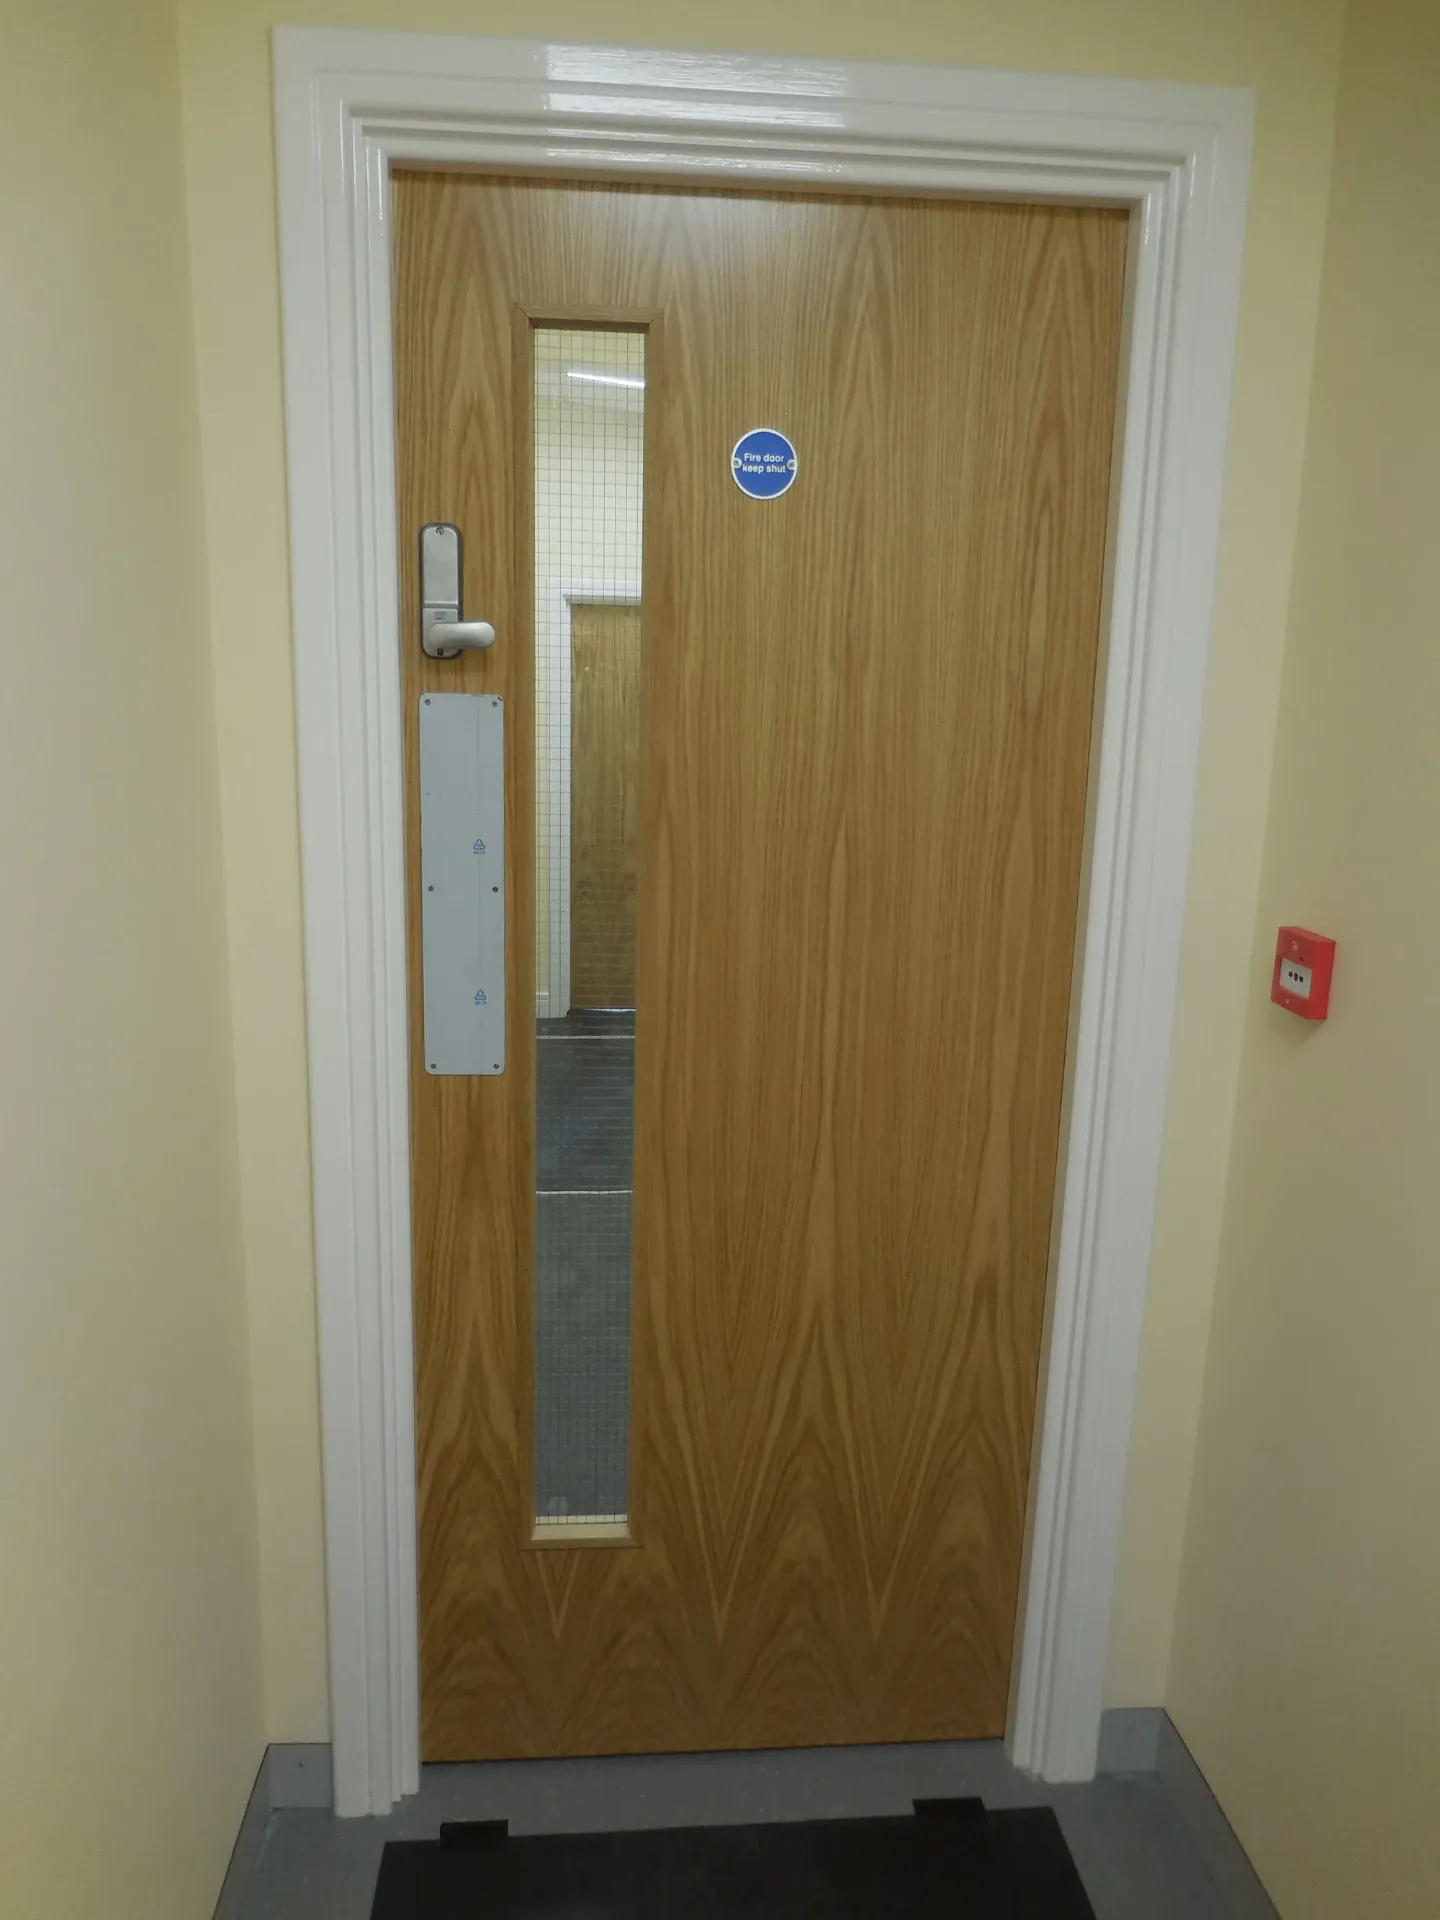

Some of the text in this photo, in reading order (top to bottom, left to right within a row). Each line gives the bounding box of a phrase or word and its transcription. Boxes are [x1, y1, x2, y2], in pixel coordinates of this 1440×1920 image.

[744, 453, 784, 462] Fire door
[742, 464, 786, 474] keep shut
